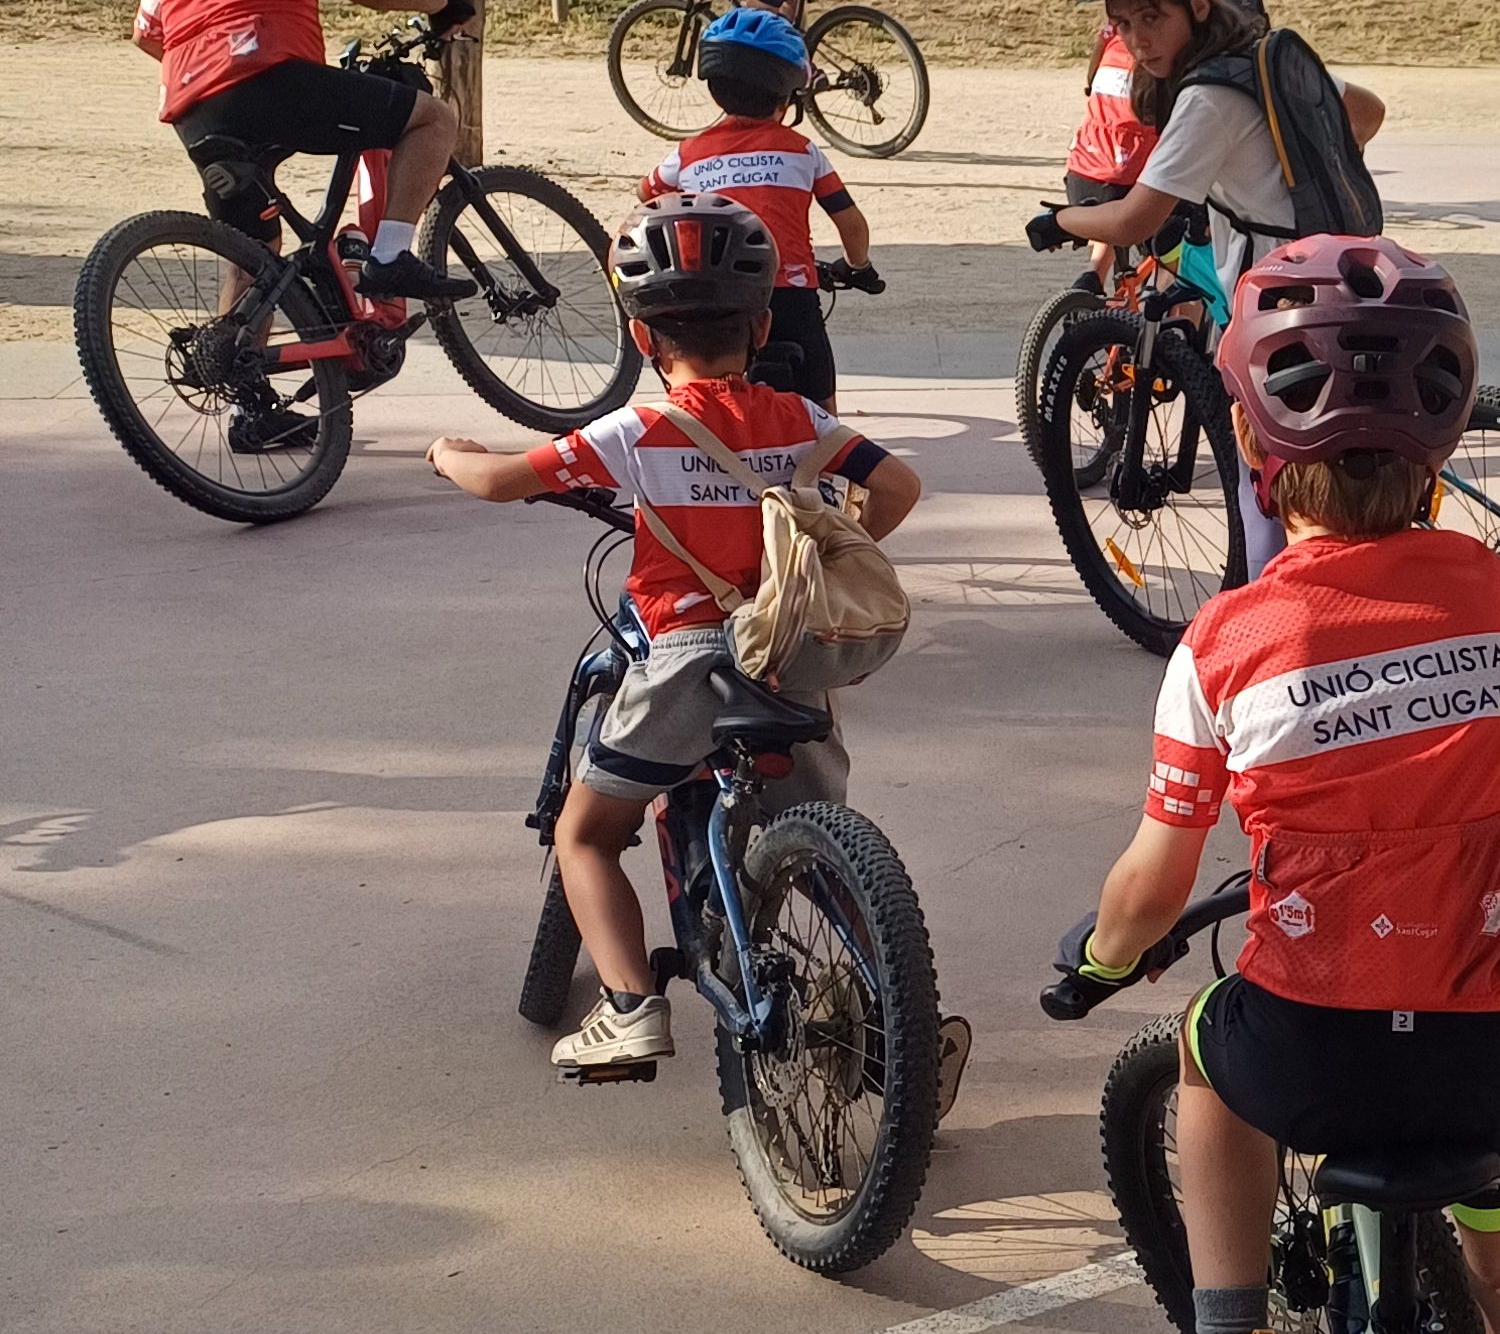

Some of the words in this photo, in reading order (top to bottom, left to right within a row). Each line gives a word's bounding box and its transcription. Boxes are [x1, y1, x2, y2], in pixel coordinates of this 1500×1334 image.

[694, 159, 724, 176] UNIÓ
[728, 155, 784, 168] CICLISTA
[699, 175, 728, 192] SANT
[732, 172, 779, 184] CUGAT
[1044, 355, 1068, 423] MAXXIS
[690, 483, 740, 502] SANT
[1288, 663, 1374, 708] UNIÓ
[1313, 704, 1396, 745] SANT
